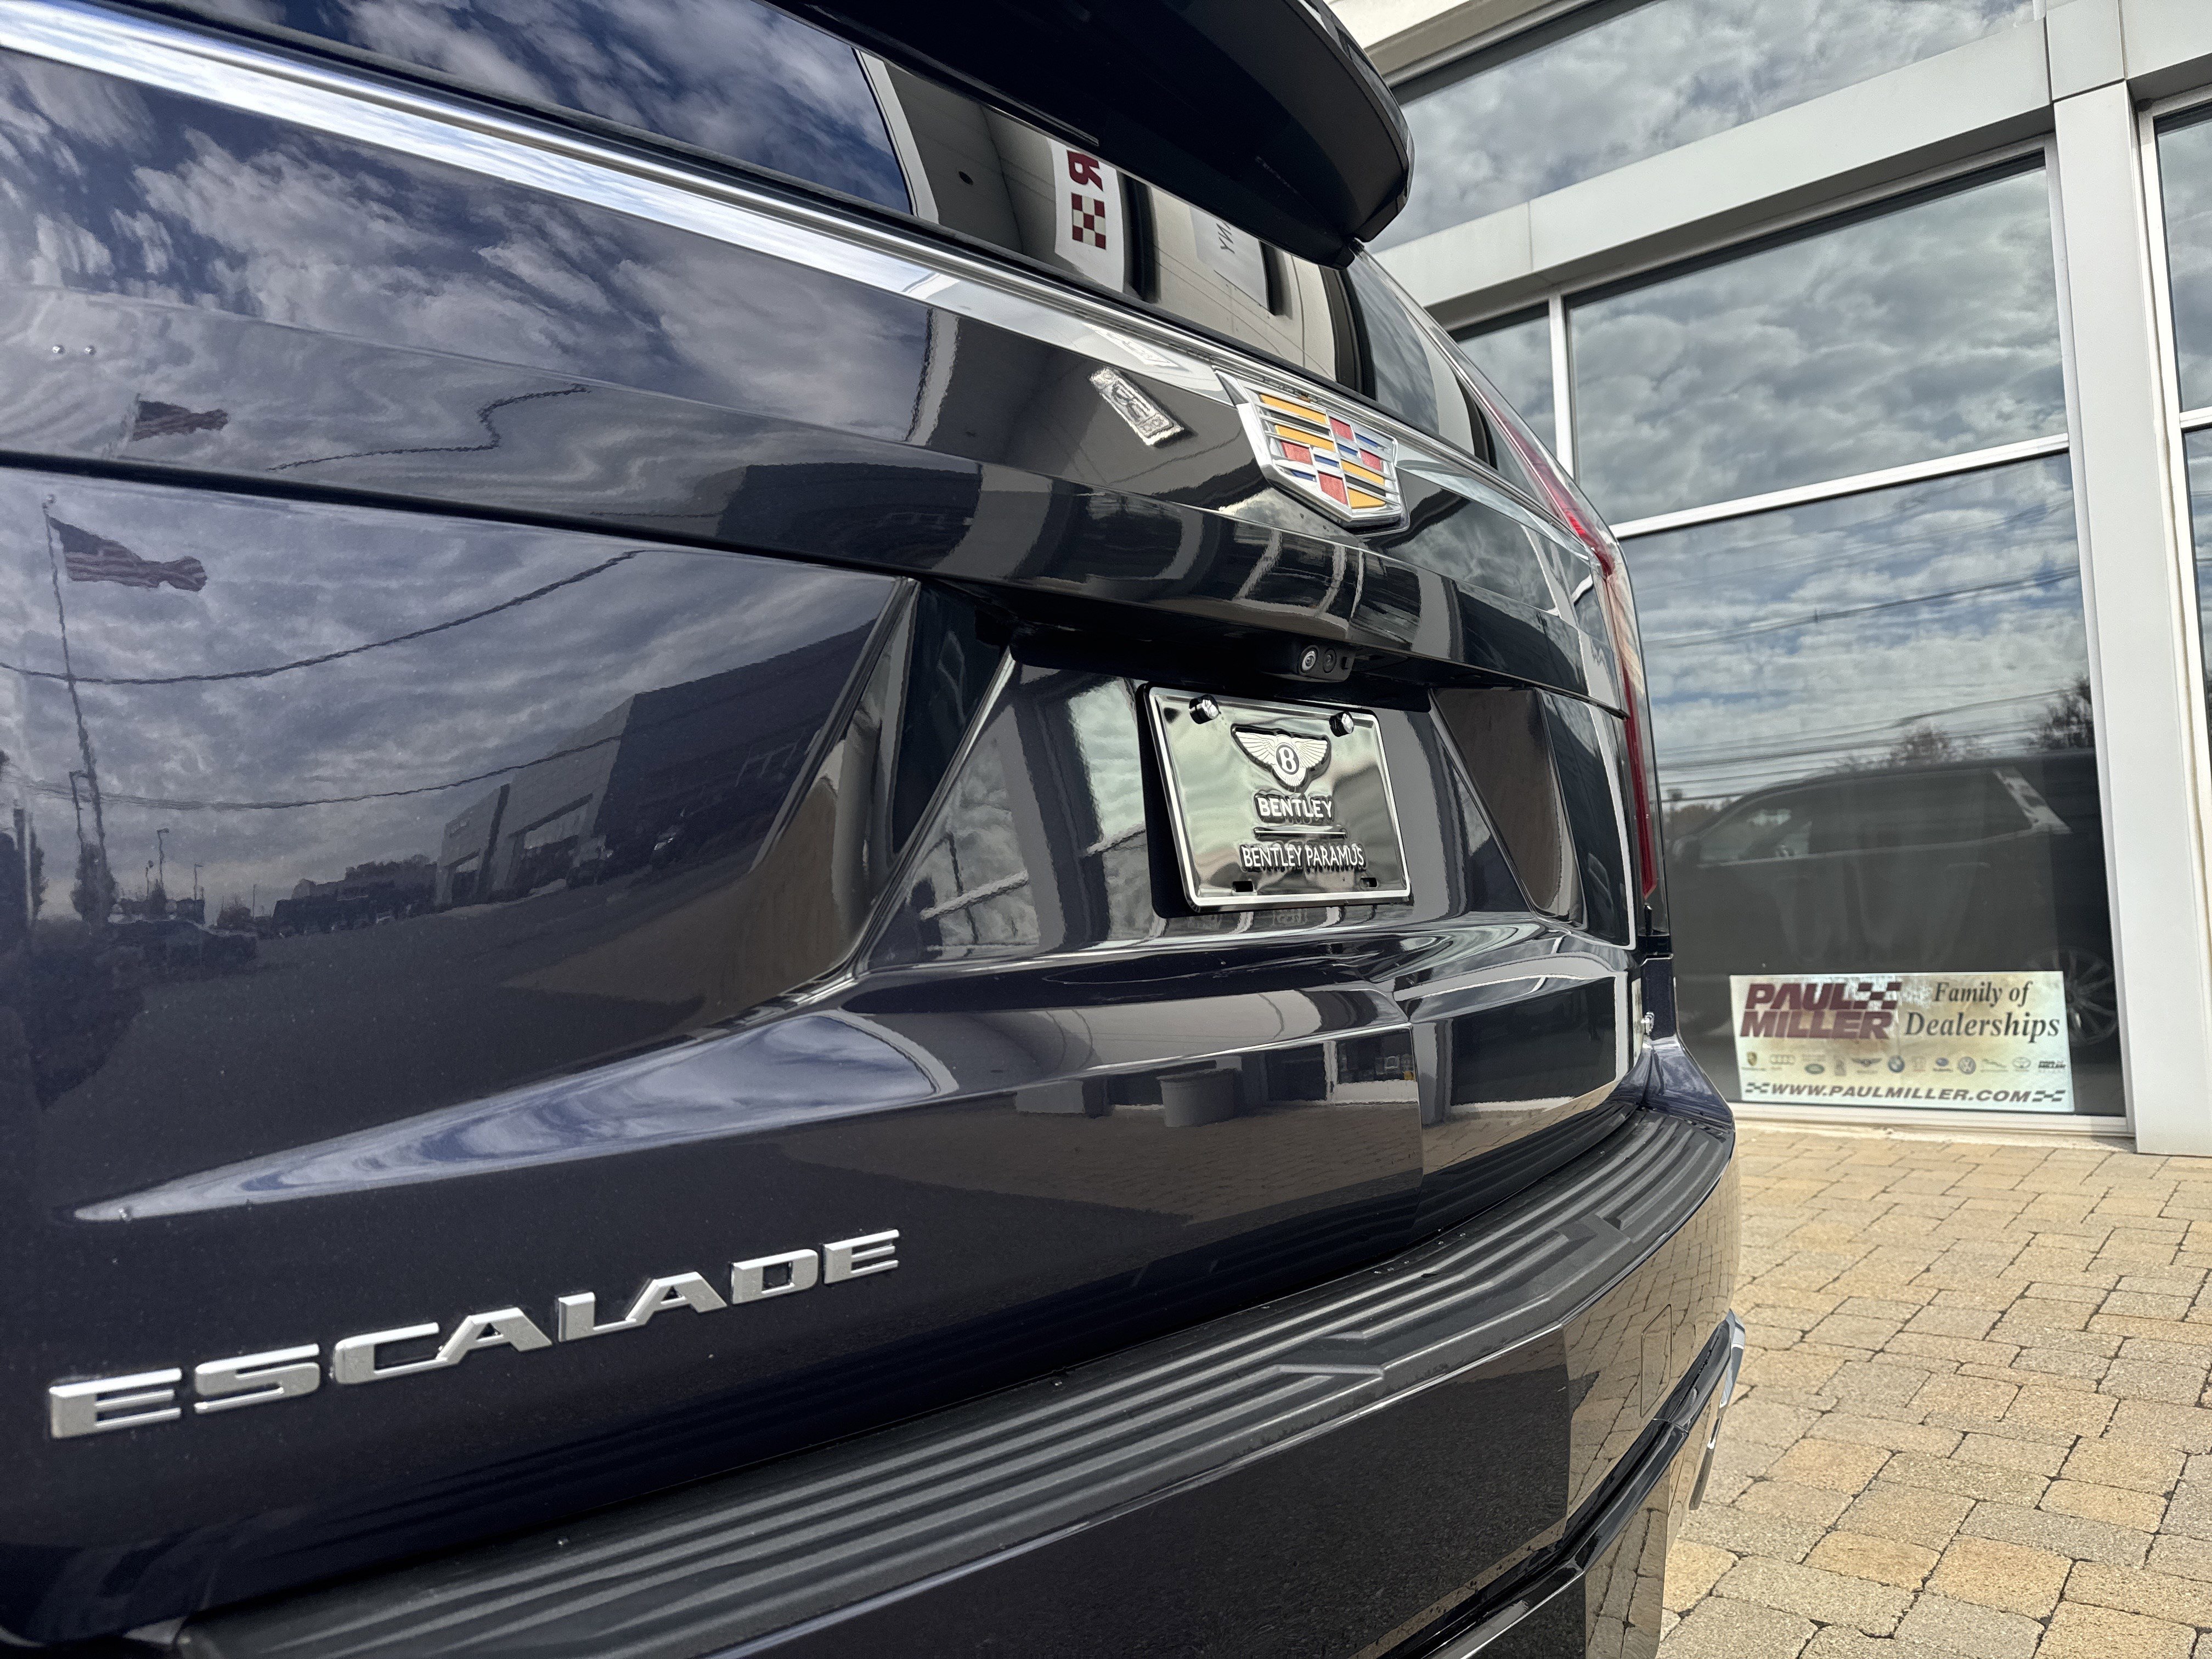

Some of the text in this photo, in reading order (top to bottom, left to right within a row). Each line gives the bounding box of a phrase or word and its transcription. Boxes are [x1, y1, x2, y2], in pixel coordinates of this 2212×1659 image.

[1257, 797, 1332, 818] BENTLEY
[1242, 845, 1364, 867] BENTLEY PARAMUS
[1745, 982, 1853, 1009] PAUL
[1934, 980, 2033, 1006] Family of
[1740, 1011, 1893, 1039] MILLER
[1904, 1012, 2060, 1043] Dealerships
[1771, 1084, 2033, 1103] WWW.PAULMILLER.COM
[49, 1228, 900, 1440] ESCALADE
